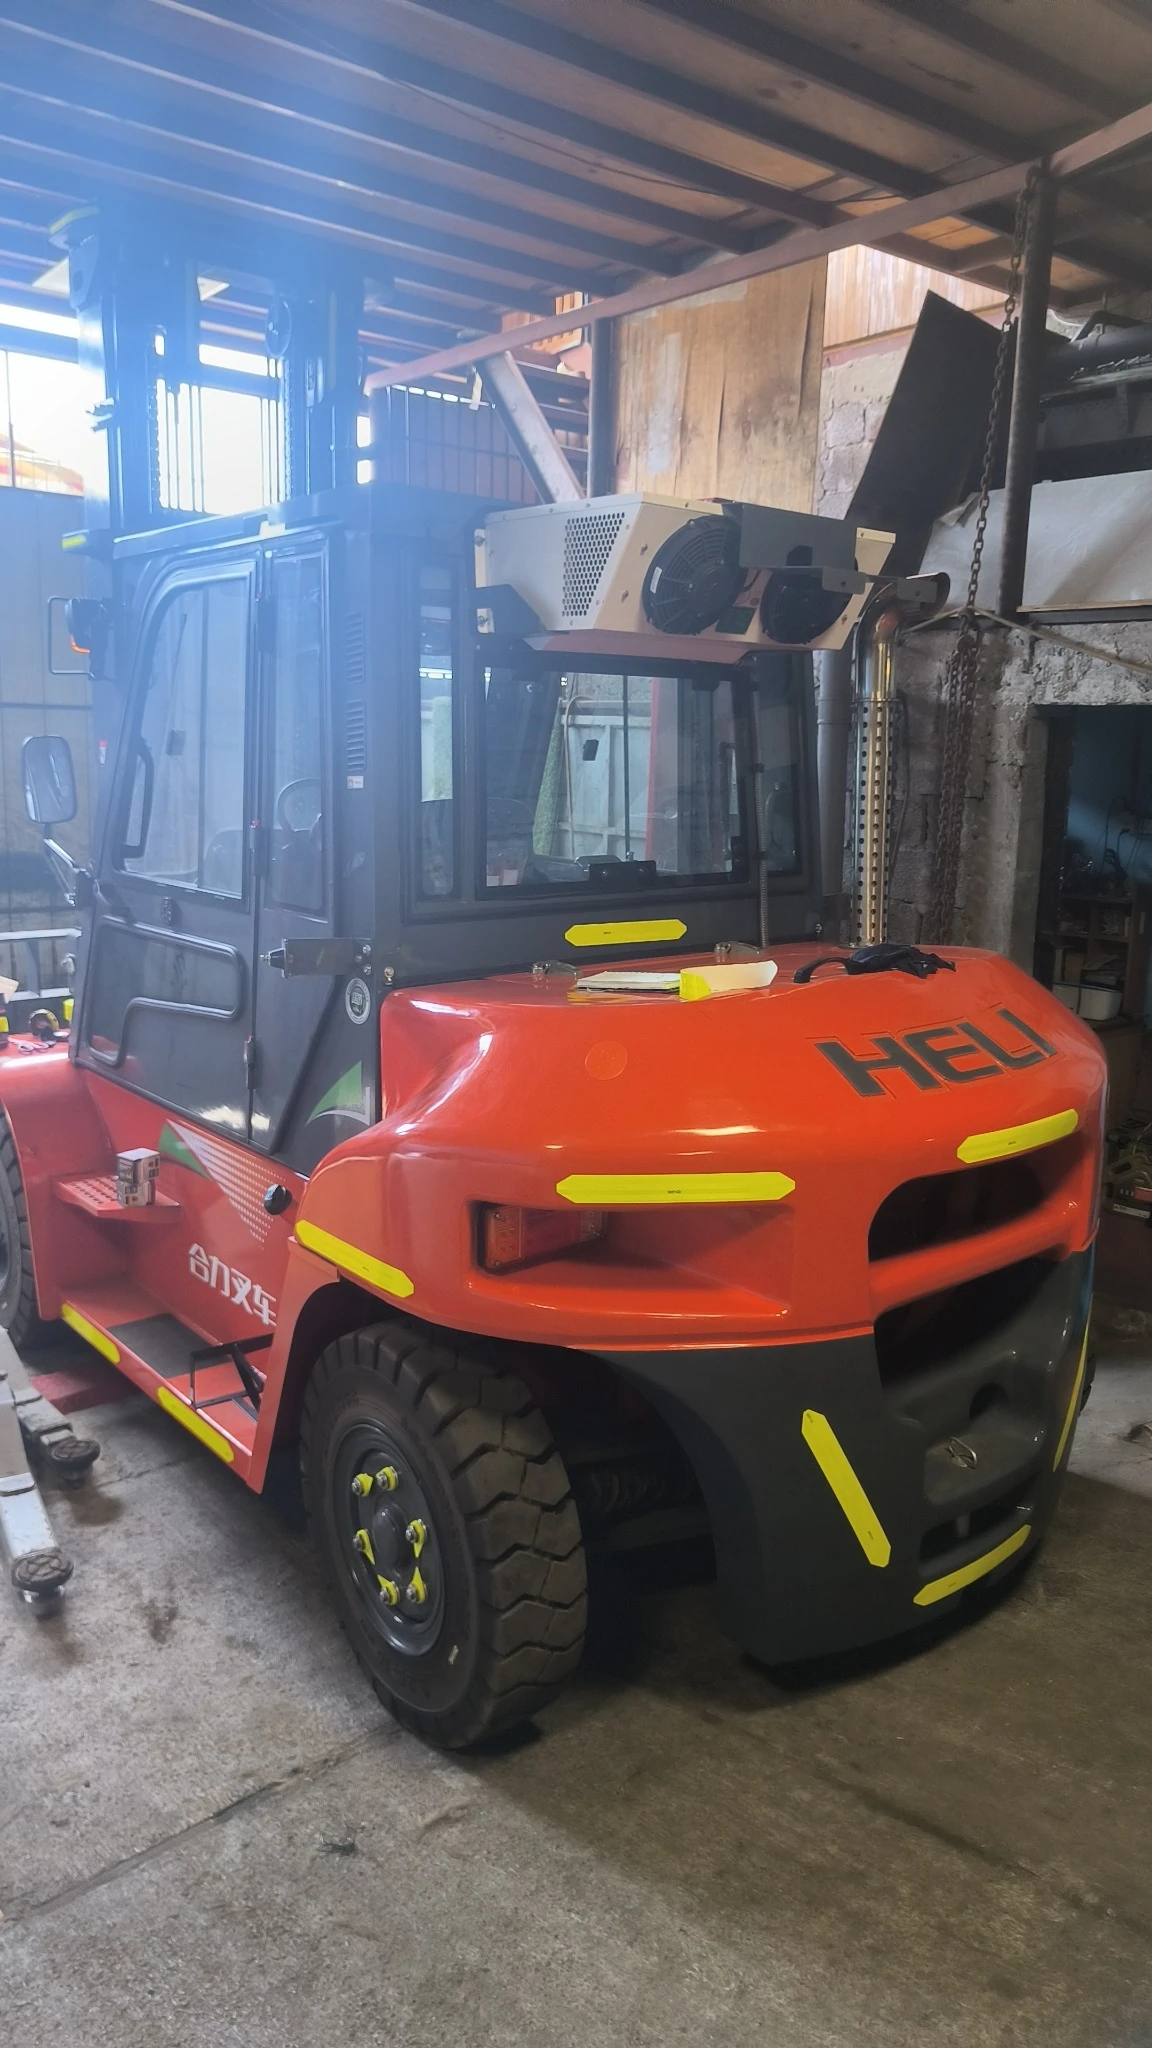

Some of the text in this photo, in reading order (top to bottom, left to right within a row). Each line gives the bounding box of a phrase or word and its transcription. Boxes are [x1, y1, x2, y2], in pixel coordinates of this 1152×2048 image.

[814, 1008, 1057, 1097] HELI
[188, 1243, 278, 1327] 合力叉车
